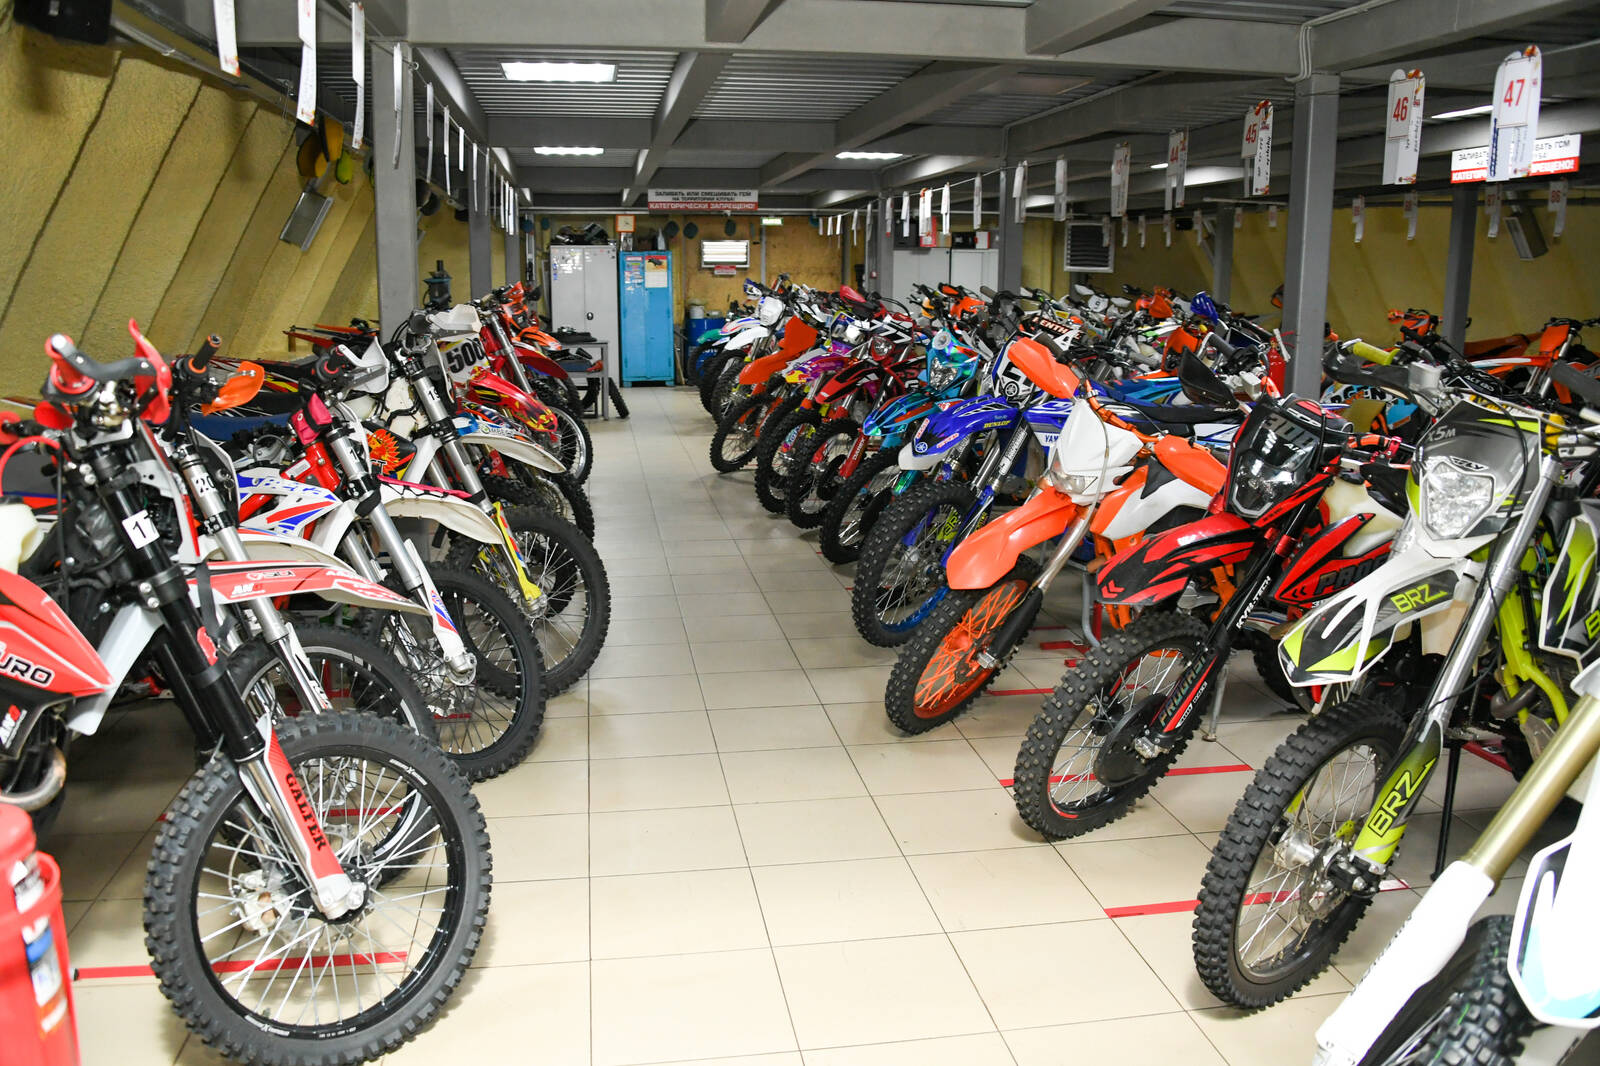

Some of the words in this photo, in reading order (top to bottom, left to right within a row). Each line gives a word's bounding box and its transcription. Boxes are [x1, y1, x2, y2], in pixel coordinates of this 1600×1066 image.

[1503, 78, 1525, 107] 47
[1393, 96, 1408, 122] 46
[1245, 123, 1257, 144] 45
[1032, 315, 1081, 341] RENTHL
[446, 337, 485, 373] 500
[1045, 434, 1059, 443] YAM
[1390, 583, 1448, 613] BRZ
[0, 655, 53, 685] URO
[1368, 756, 1438, 837] BRZ
[285, 772, 328, 852] GALFER
